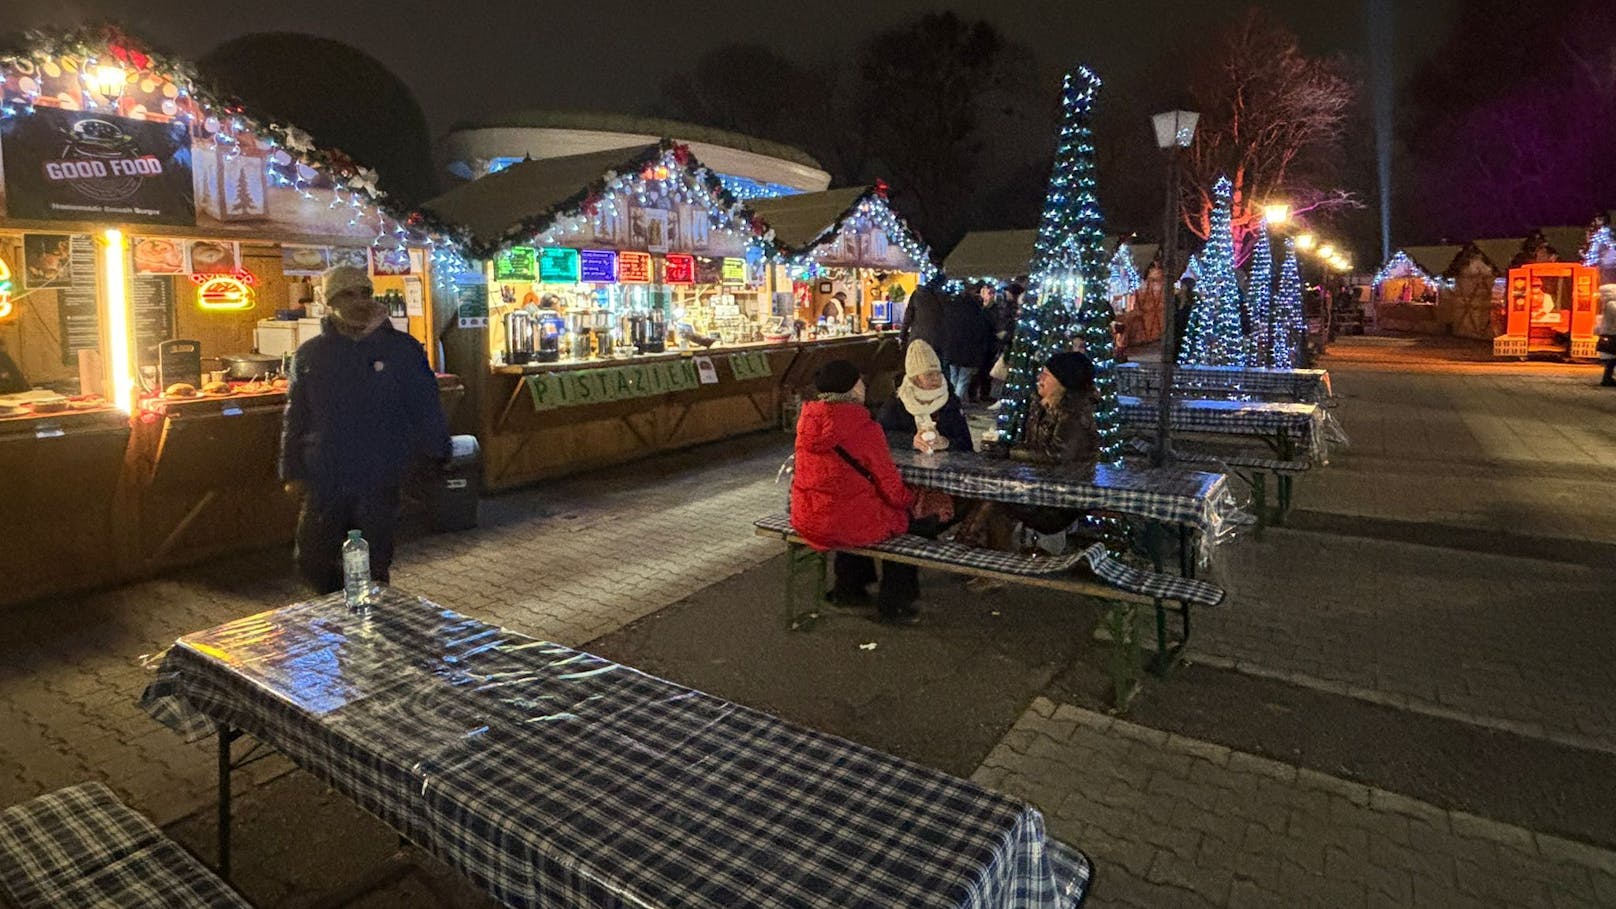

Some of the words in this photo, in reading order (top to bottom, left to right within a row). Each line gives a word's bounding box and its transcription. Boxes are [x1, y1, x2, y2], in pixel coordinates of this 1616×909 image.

[46, 160, 107, 180] GOOD
[110, 157, 163, 176] FOOD
[532, 362, 695, 404] PISTAZIEN
